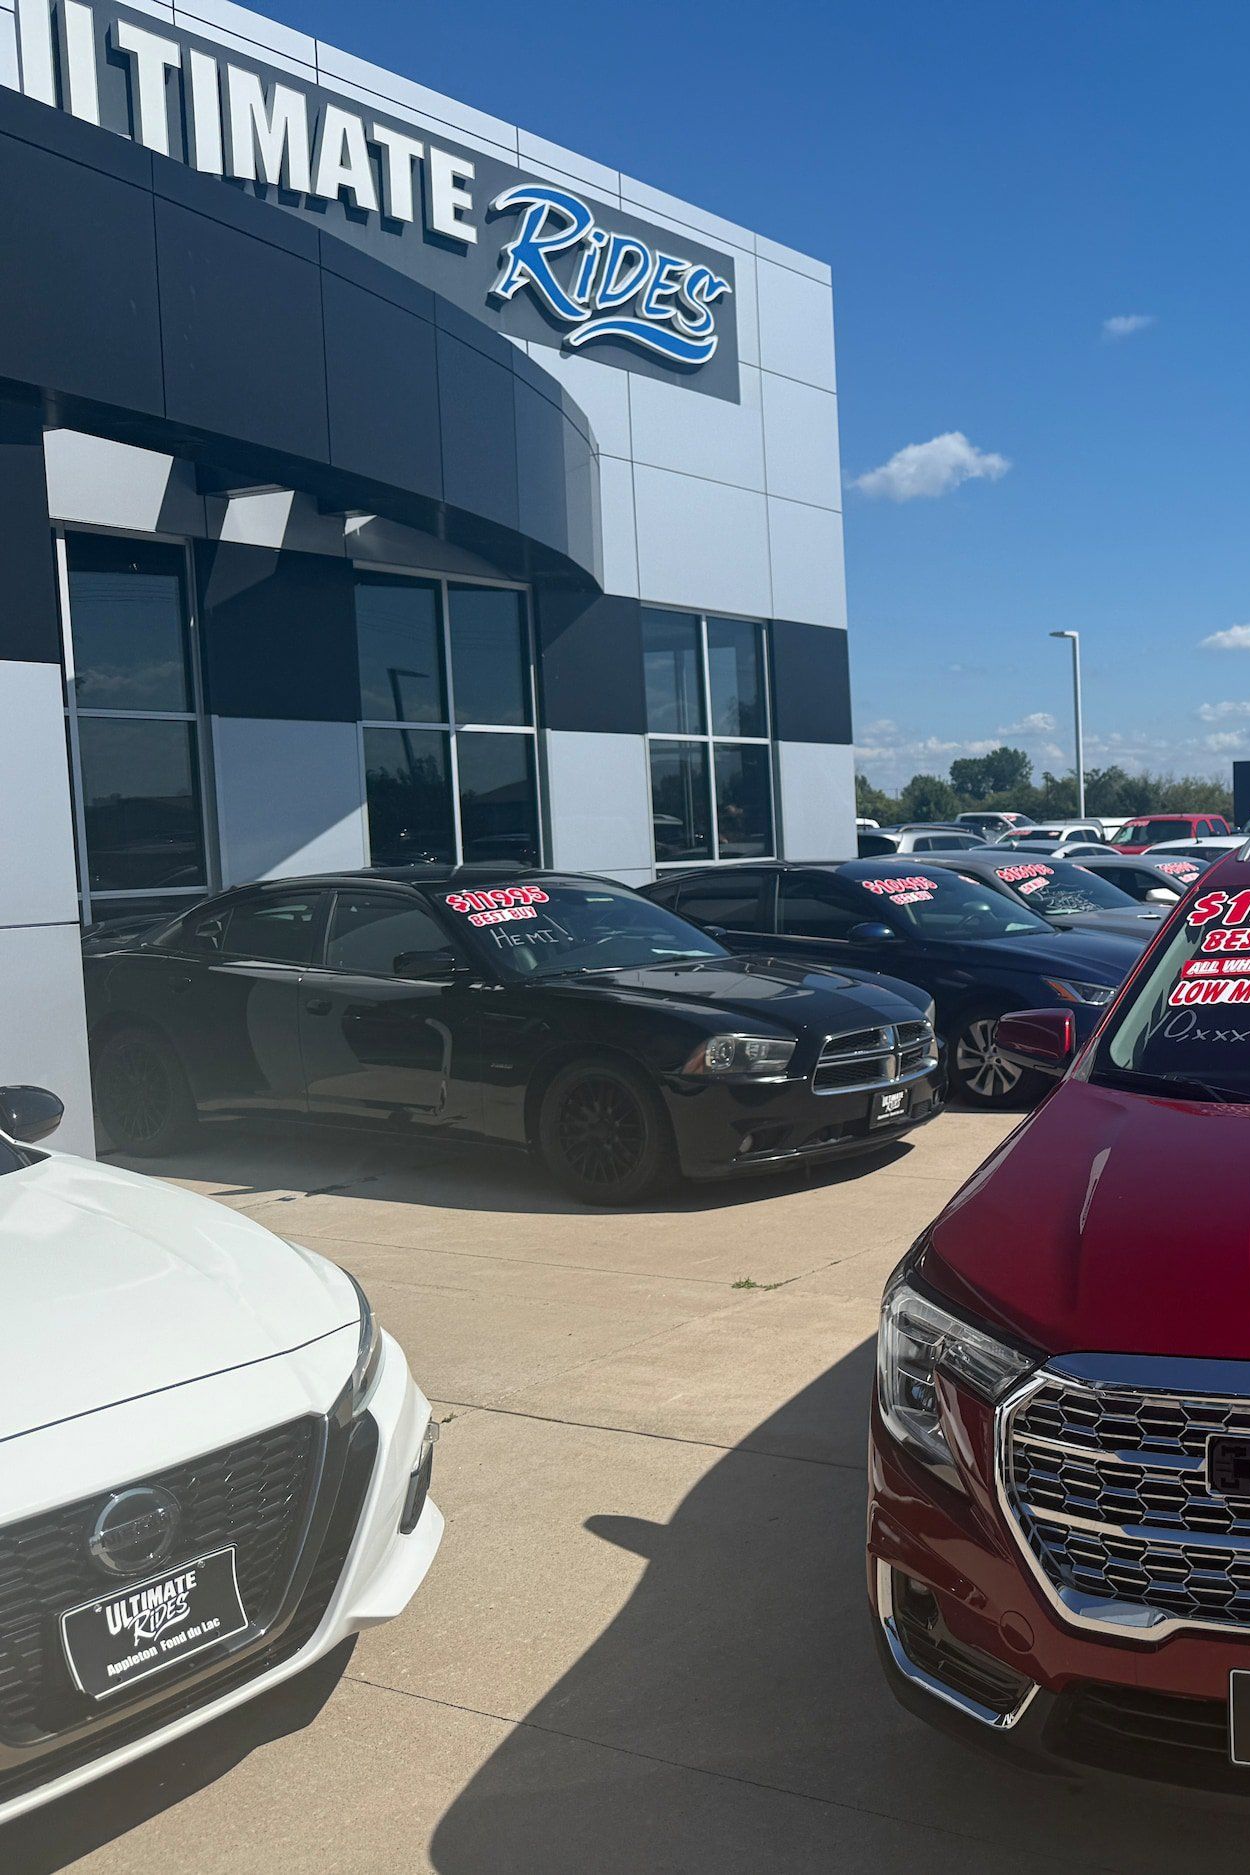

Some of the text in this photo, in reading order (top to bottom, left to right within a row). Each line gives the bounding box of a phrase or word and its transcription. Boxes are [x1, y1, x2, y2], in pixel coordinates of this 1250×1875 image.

[446, 886, 549, 912] $11995
[468, 906, 538, 927] BEST BUY
[1186, 960, 1219, 975] ALL
[1168, 979, 1229, 1006] LOW
[105, 1570, 198, 1636] ULTIMATE
[106, 1617, 221, 1677] Appleton Fond du Lac
